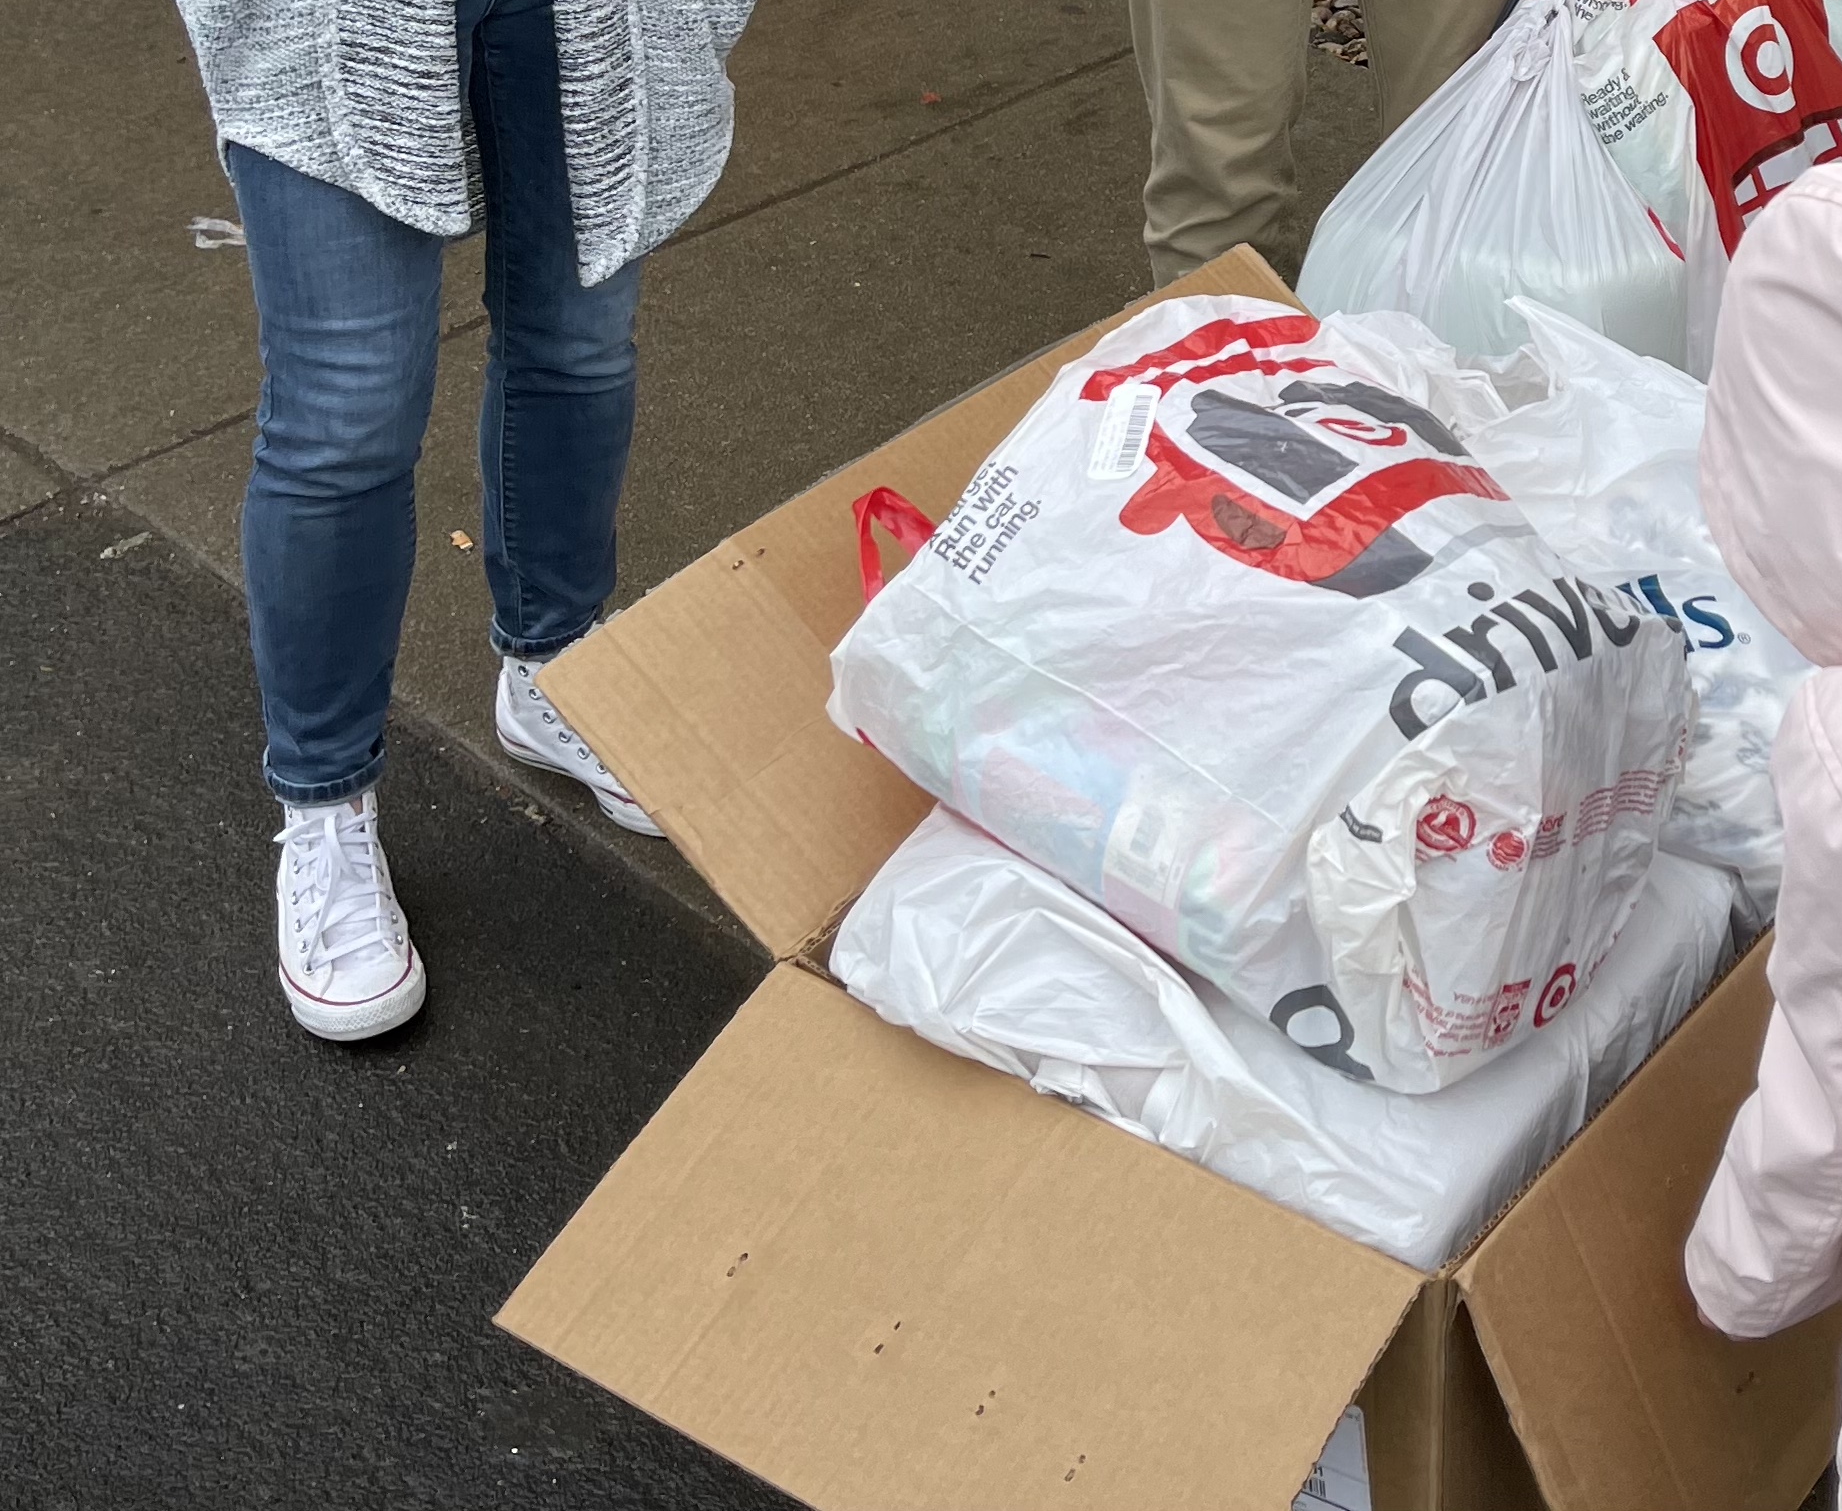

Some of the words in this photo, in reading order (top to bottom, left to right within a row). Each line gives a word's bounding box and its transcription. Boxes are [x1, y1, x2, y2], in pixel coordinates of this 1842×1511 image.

[1621, 67, 1631, 82] &
[1588, 85, 1637, 120] waiting
[1593, 93, 1643, 133] without
[1600, 128, 1625, 146] the
[1624, 91, 1669, 132] waiting.
[934, 514, 977, 562] Run
[972, 465, 1019, 512] with
[952, 532, 987, 571] the
[985, 492, 1017, 530] car
[968, 499, 1042, 586] running.
